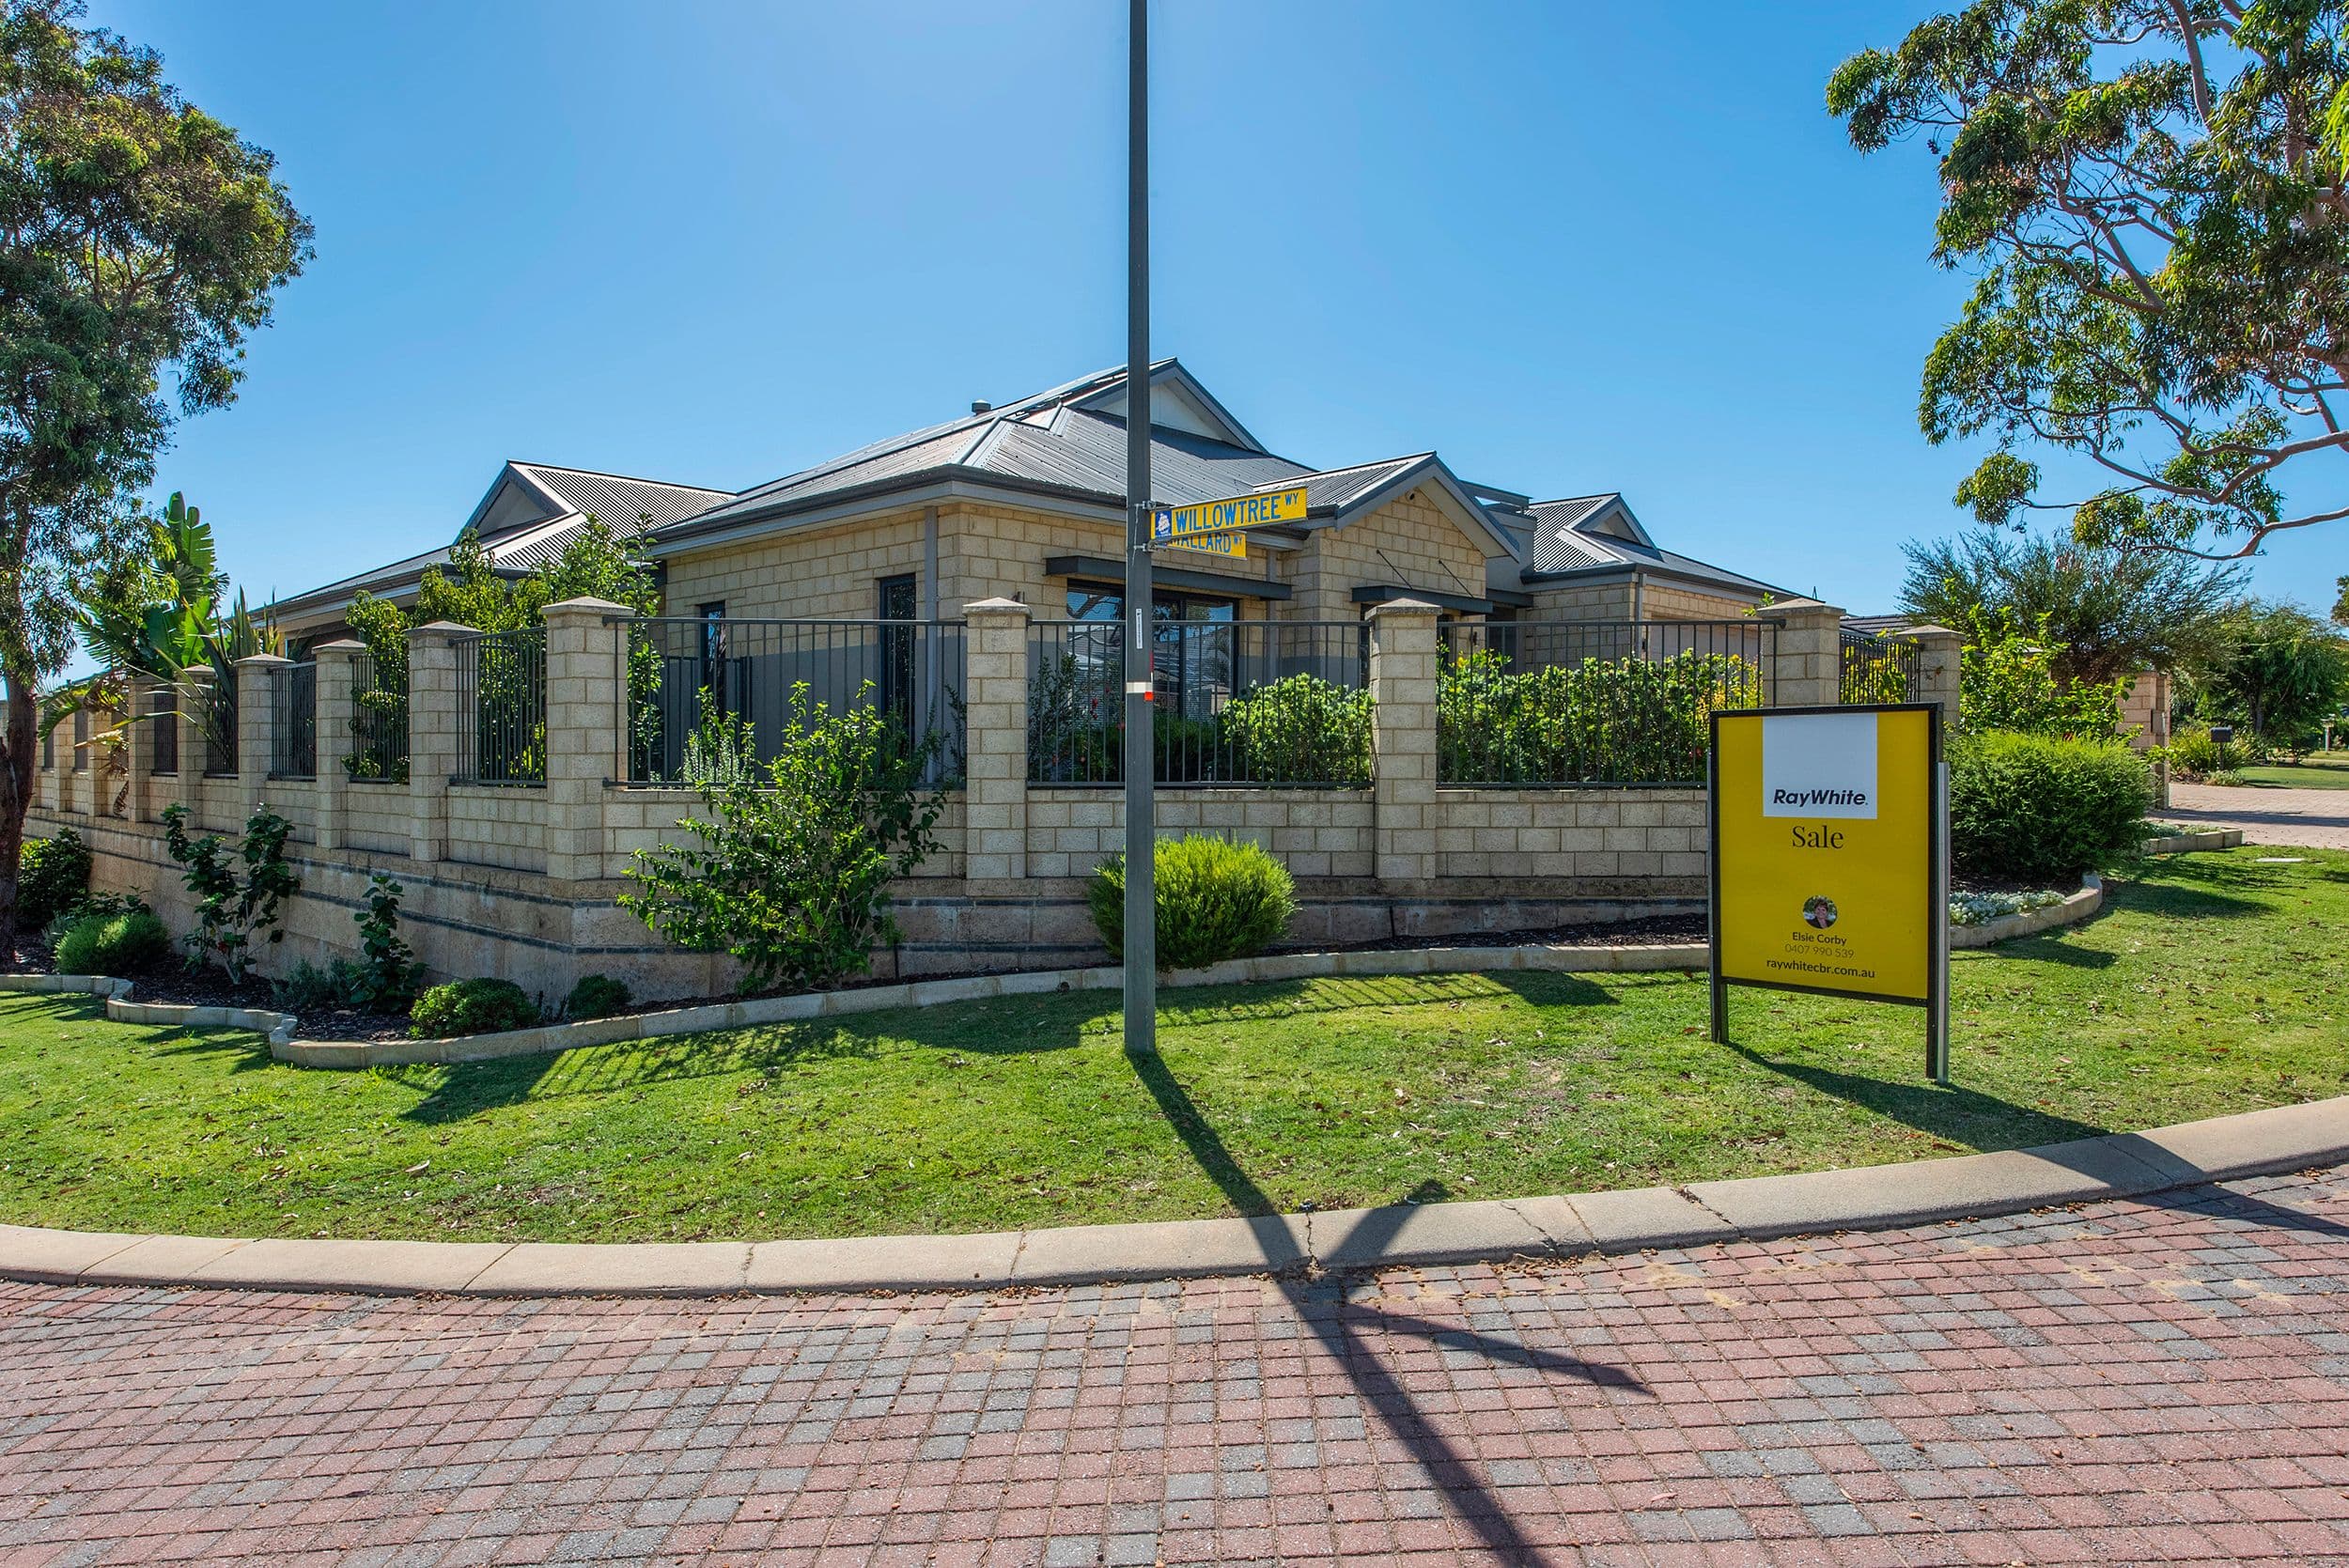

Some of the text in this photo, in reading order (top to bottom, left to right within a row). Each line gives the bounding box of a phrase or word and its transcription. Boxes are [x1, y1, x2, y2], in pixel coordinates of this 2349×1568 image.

[1175, 492, 1299, 533] WILLOWTREE WY
[1792, 825, 1843, 849] Sale
[1792, 931, 1847, 947] Elsie Corby
[1785, 943, 1855, 959] 0407 990 539
[1766, 959, 1875, 979] raywhitecbr.com.au
